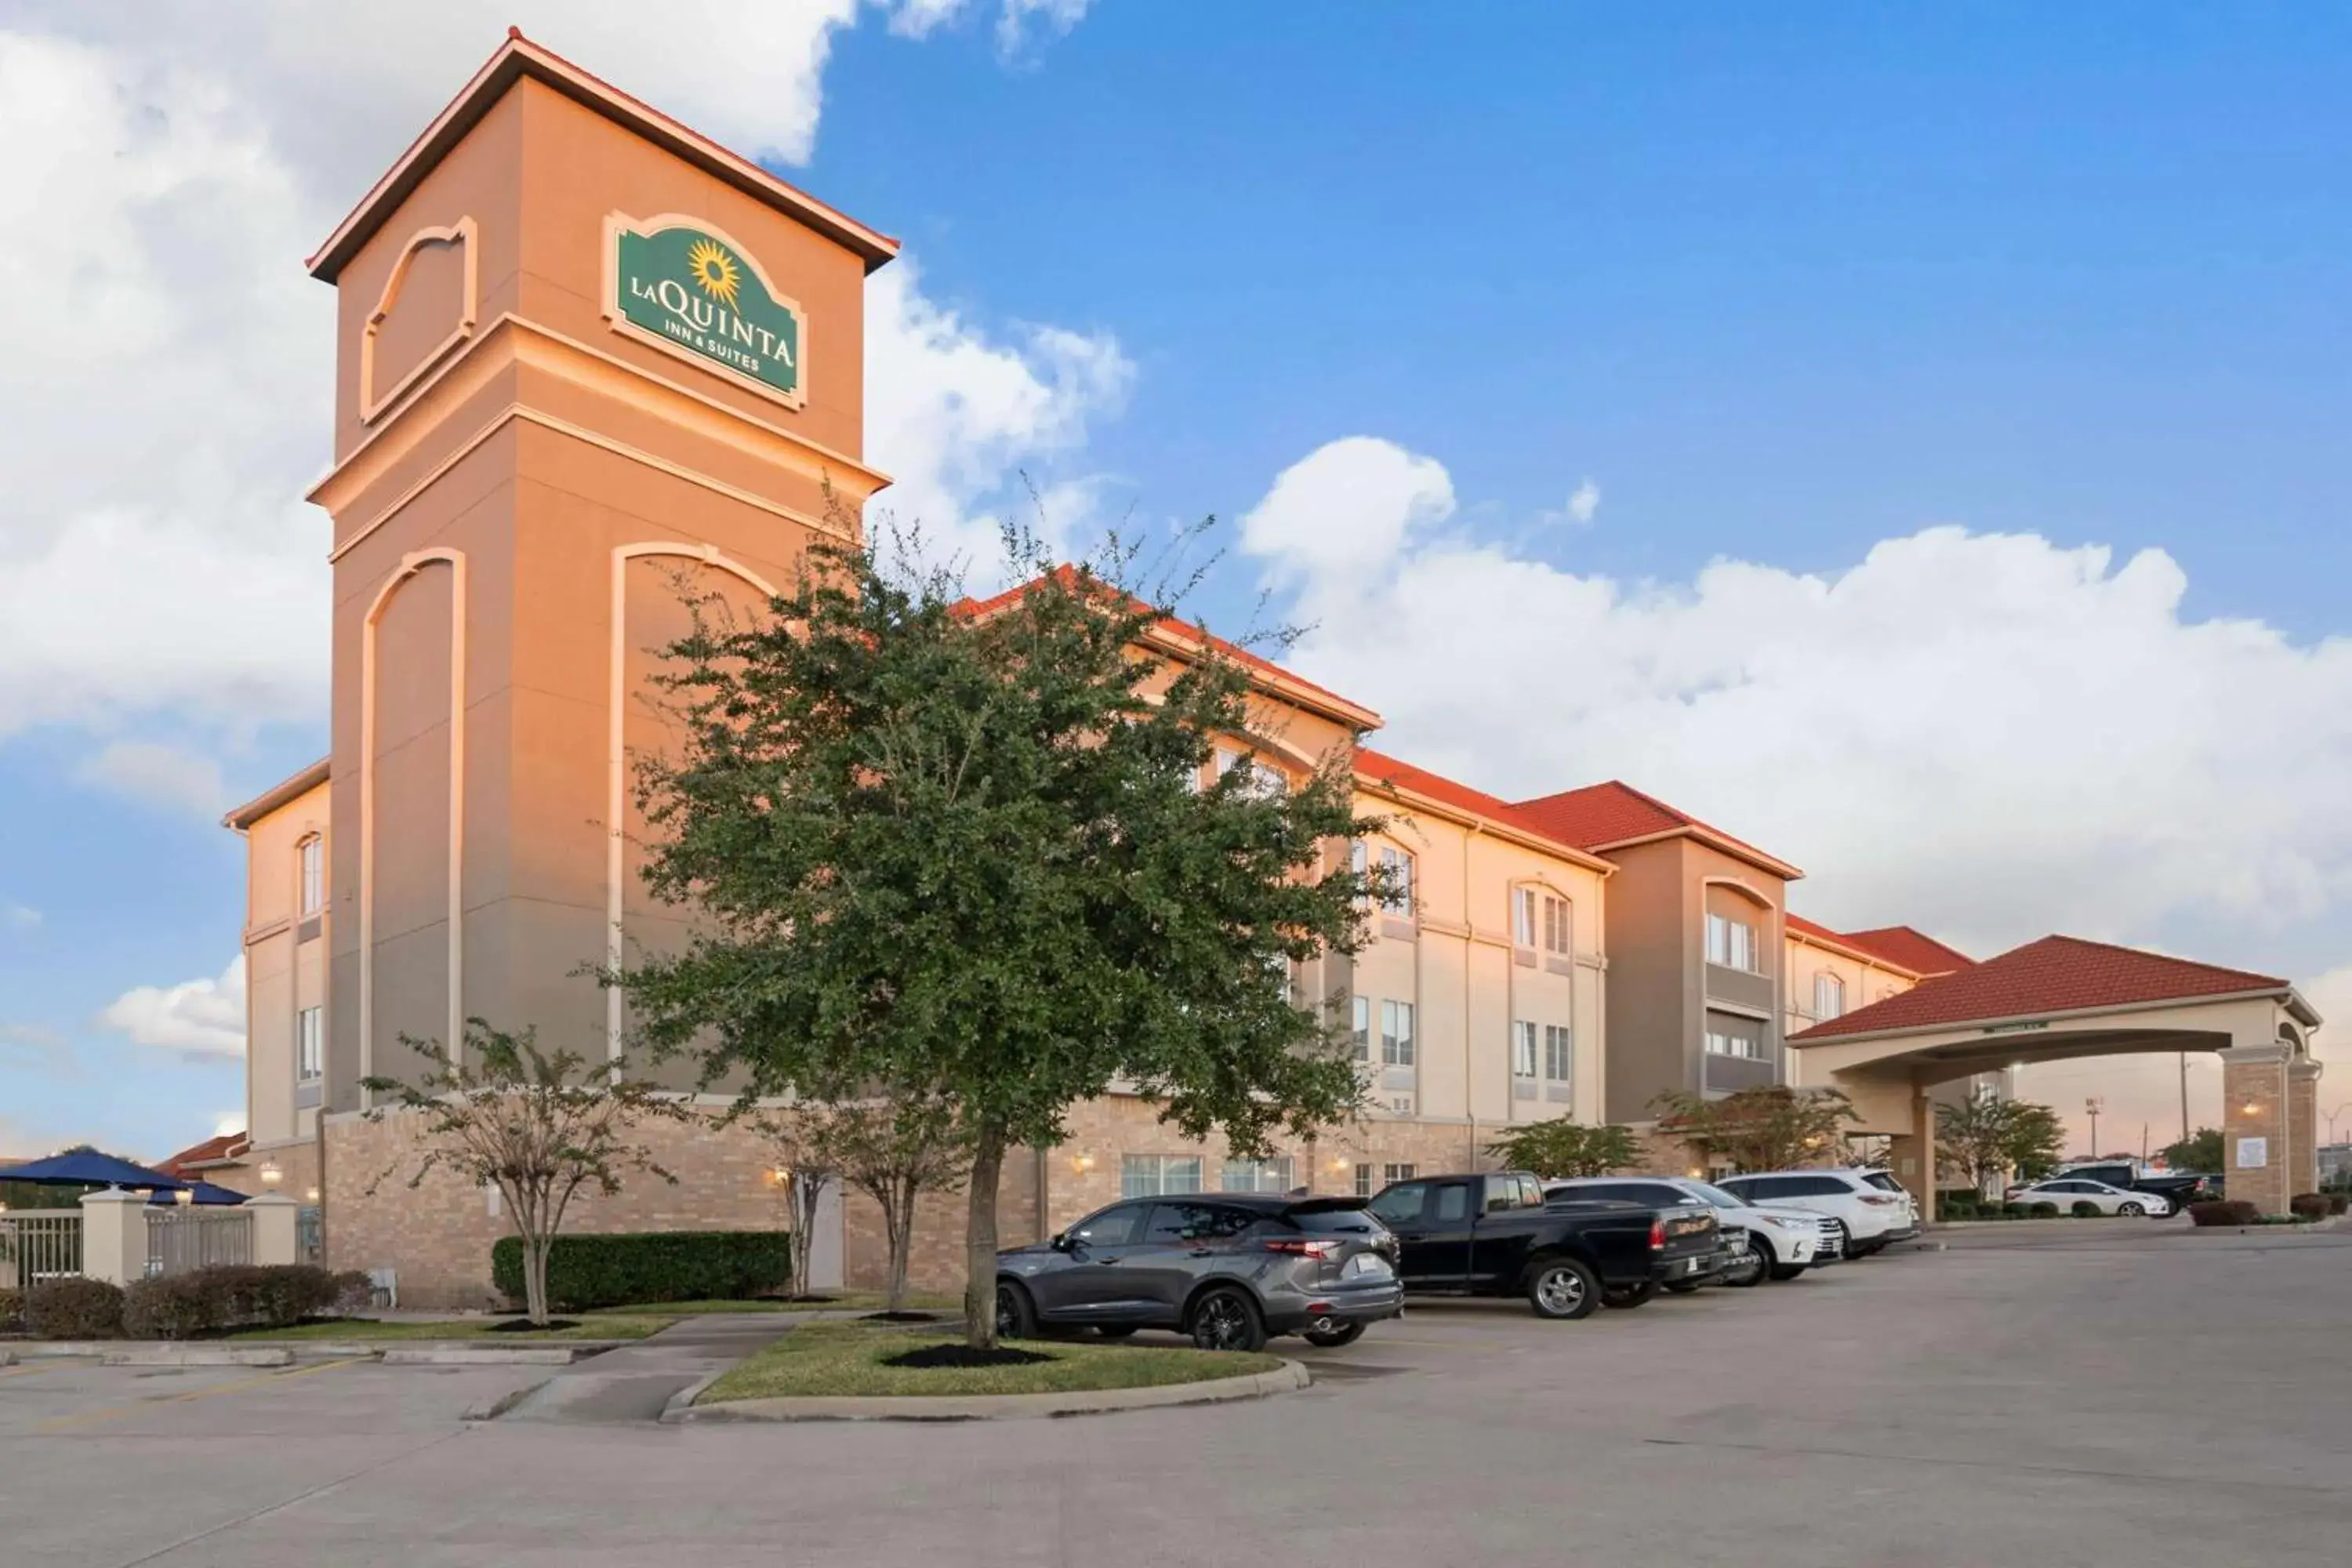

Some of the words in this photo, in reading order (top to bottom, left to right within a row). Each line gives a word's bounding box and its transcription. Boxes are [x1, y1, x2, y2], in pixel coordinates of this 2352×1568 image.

[666, 320, 691, 339] INN
[695, 336, 704, 347] &
[708, 339, 759, 372] SUITES
